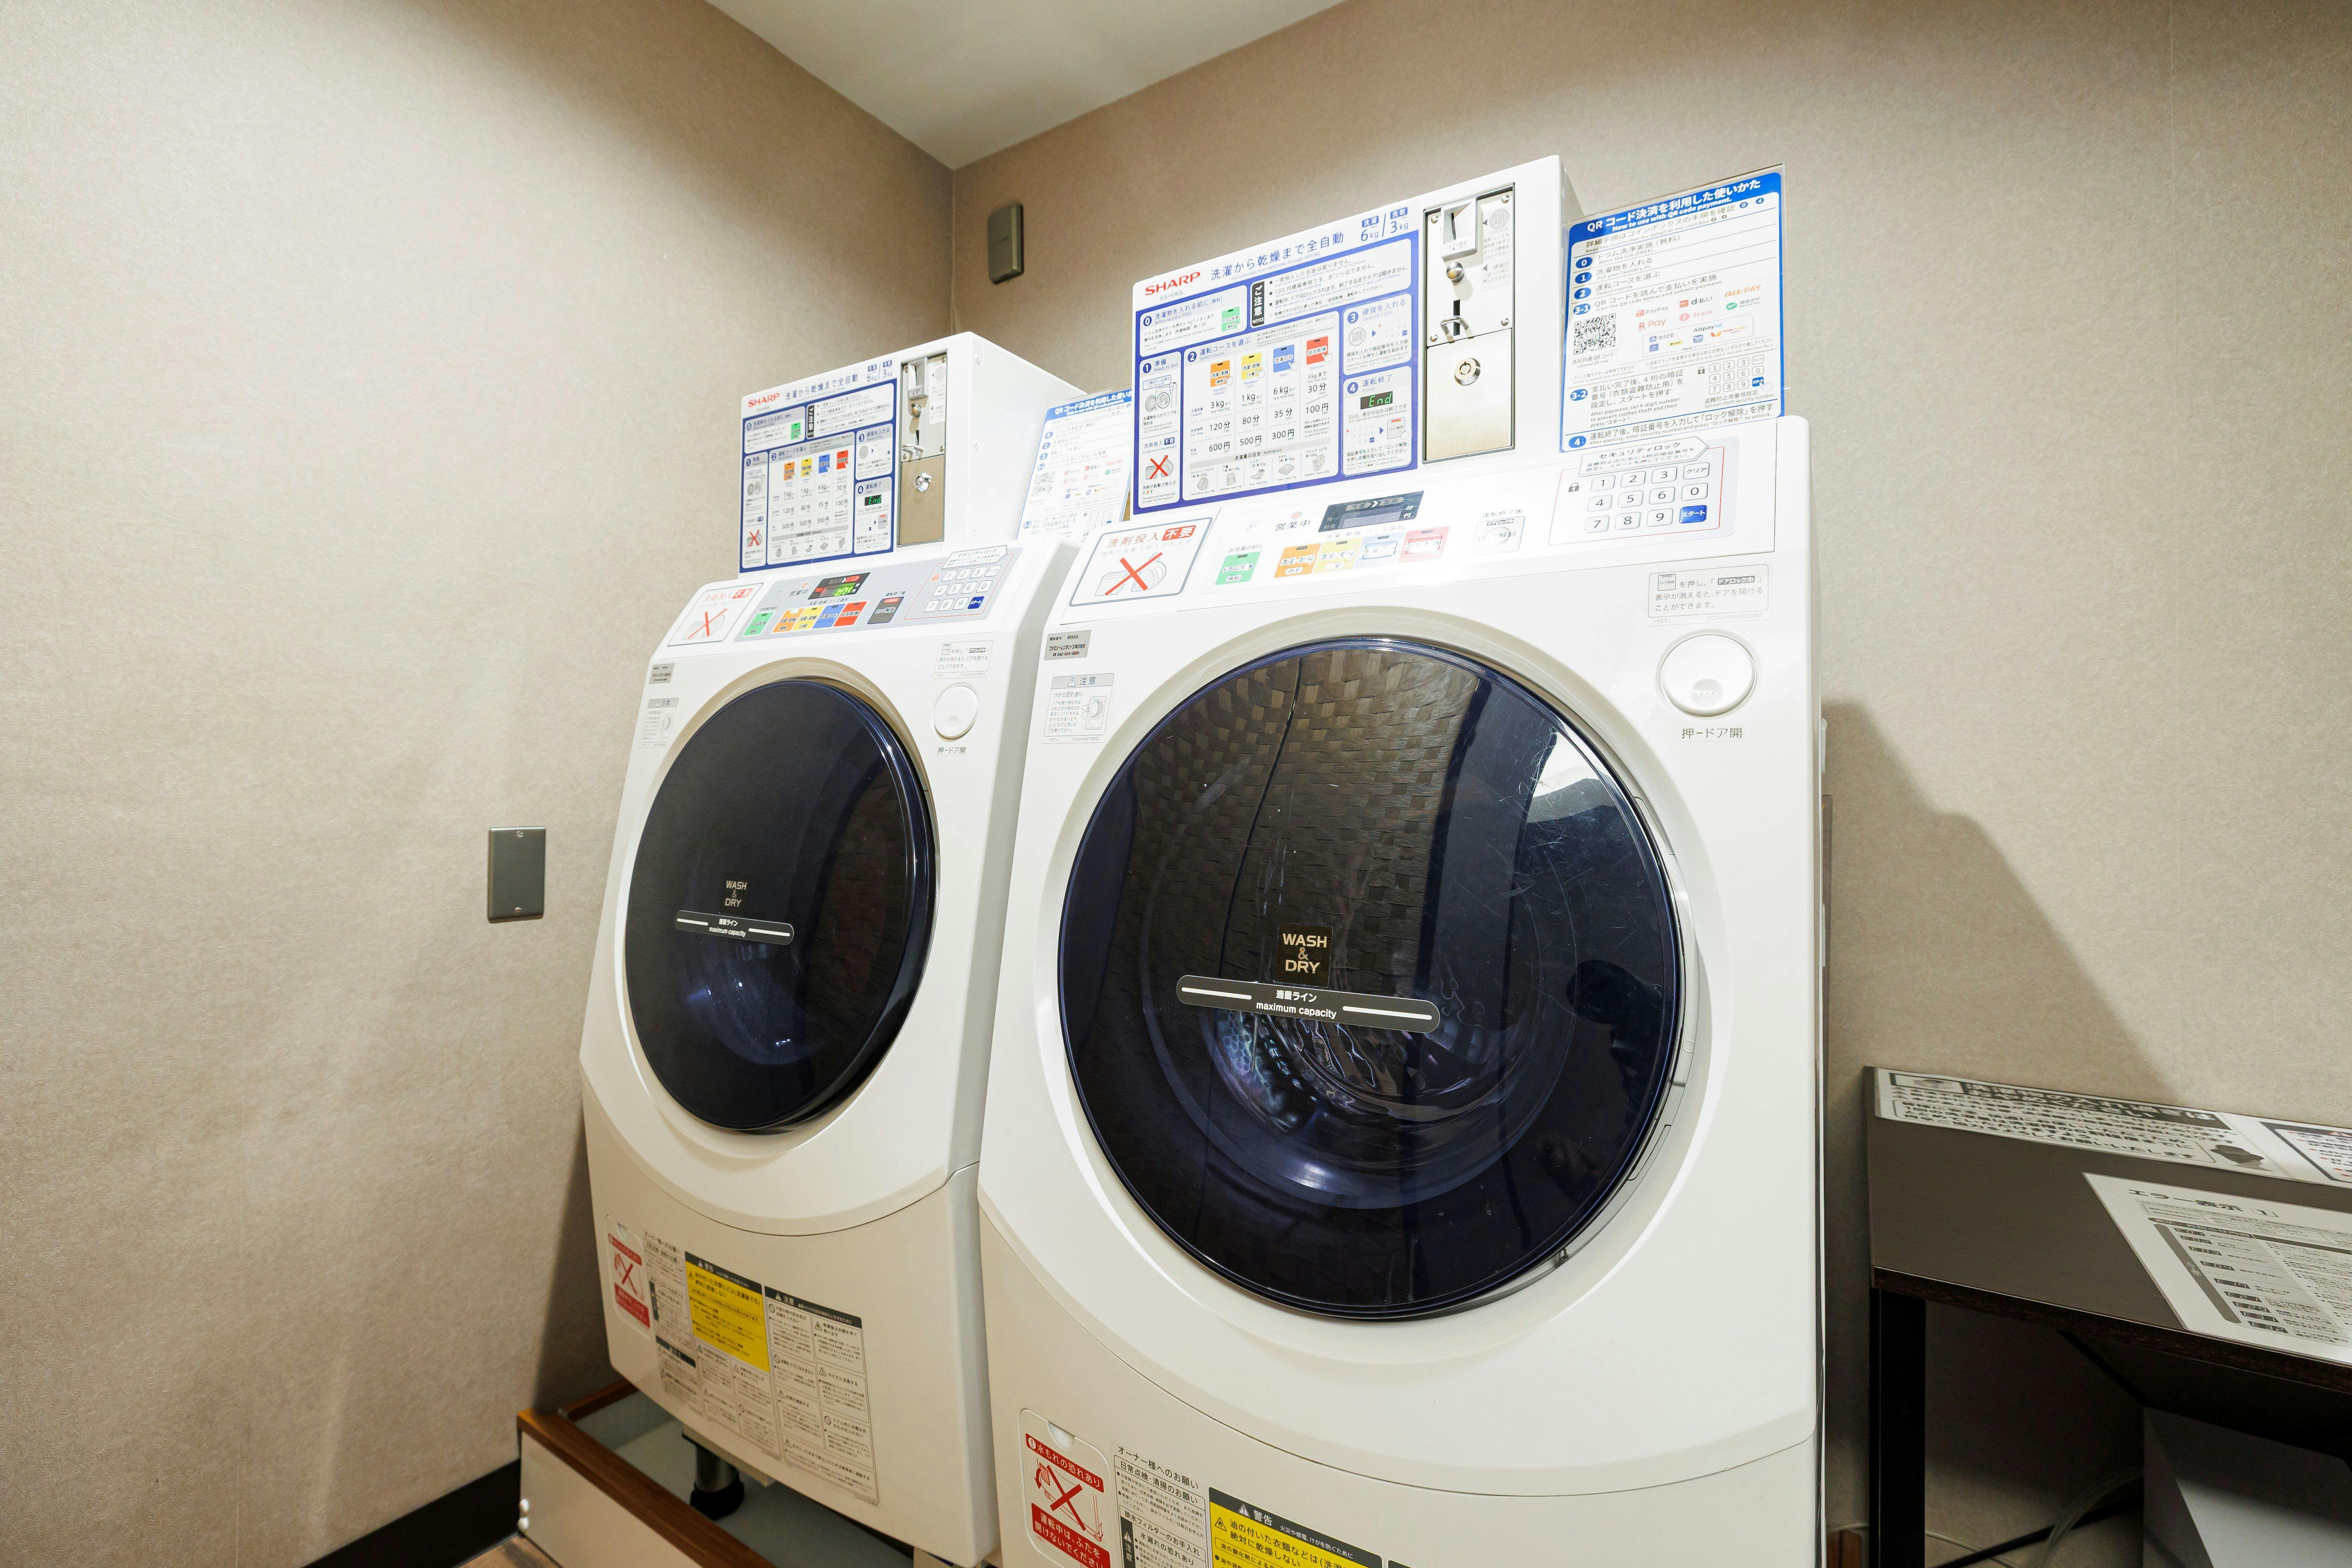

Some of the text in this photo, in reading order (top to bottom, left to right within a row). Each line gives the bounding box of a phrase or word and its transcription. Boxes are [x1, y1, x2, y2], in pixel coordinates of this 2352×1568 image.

[1651, 214, 1666, 223] with
[1679, 206, 1697, 214] code
[1697, 198, 1732, 211] payment.
[1610, 237, 1640, 247] instruction
[1211, 231, 1344, 281] 洗濯から乾燥まで全自動
[1268, 261, 1287, 270] WASHING
[1596, 257, 1653, 276] 洗濯物を入れる
[1621, 266, 1643, 274] laundry
[1145, 272, 1200, 295] SHARP
[1595, 272, 1660, 291] 運転コースを選ぶ
[1695, 281, 1724, 291] payment.
[1160, 290, 1184, 300] ES-HD63L
[1744, 285, 1761, 293] PAY
[1253, 285, 1263, 317] ご注意
[1362, 299, 1406, 315] 硬貨を入れる
[1155, 299, 1209, 319] 洗濯物を入れる前に
[1646, 306, 1669, 314] PayPay
[1648, 318, 1666, 328] Pay
[1200, 337, 1251, 356] 運転コースを選ぶ
[785, 374, 859, 401] 洗濯から乾燥まで全自動
[1362, 374, 1393, 387] 運転終了
[748, 392, 780, 407] SHARP
[1369, 392, 1392, 407] End
[1274, 408, 1293, 419] 35分
[1305, 403, 1329, 414] 100円
[1605, 407, 1629, 415] payment,
[1210, 420, 1230, 431] 120分
[1242, 415, 1260, 424] 80分
[1240, 435, 1262, 446] 500円
[1272, 429, 1295, 440] 300円
[1144, 440, 1163, 449] 洗剤投入
[1209, 441, 1230, 452] 600円
[1599, 442, 1681, 459] セキュリティロック
[1234, 451, 1262, 461] 洗濯量の目安
[1660, 471, 1668, 479] 3
[868, 495, 881, 505] End
[1658, 491, 1666, 499] 6
[1690, 487, 1699, 496] 0
[1275, 519, 1311, 531] 営業中
[1594, 520, 1601, 528] 7
[1624, 516, 1632, 525] 8
[1656, 513, 1664, 521] 9
[1107, 526, 1194, 548] 洗剤投入 不要
[1655, 587, 1764, 601] 表示が消えると、ドアを開ける
[1655, 602, 1715, 612] ことができます。
[1079, 677, 1096, 686] 注意
[726, 880, 747, 890] WASH
[724, 898, 742, 907] DRY
[709, 927, 746, 937] maximum capacity
[1282, 933, 1327, 948] WASH
[1298, 946, 1308, 961] &
[1285, 959, 1320, 974] DRY
[1275, 989, 1317, 1003] 適量ライン
[1256, 1001, 1337, 1020] maximum capacity
[2127, 1189, 2244, 1212] エラー表示
[1037, 1443, 1100, 1488] 水もれの恐れあり
[1118, 1446, 1198, 1489] オーナー様へのお願い
[1040, 1512, 1100, 1559] 運転中は、ふたを
[1124, 1510, 1200, 1556] 排水フィルターのお手入れ
[1253, 1509, 1354, 1559] 警告 火災や感電、けがを防ぐために
[1140, 1532, 1194, 1566] 水漏れの恐れあり
[1230, 1531, 1300, 1568] 絶対に乾燥しない
